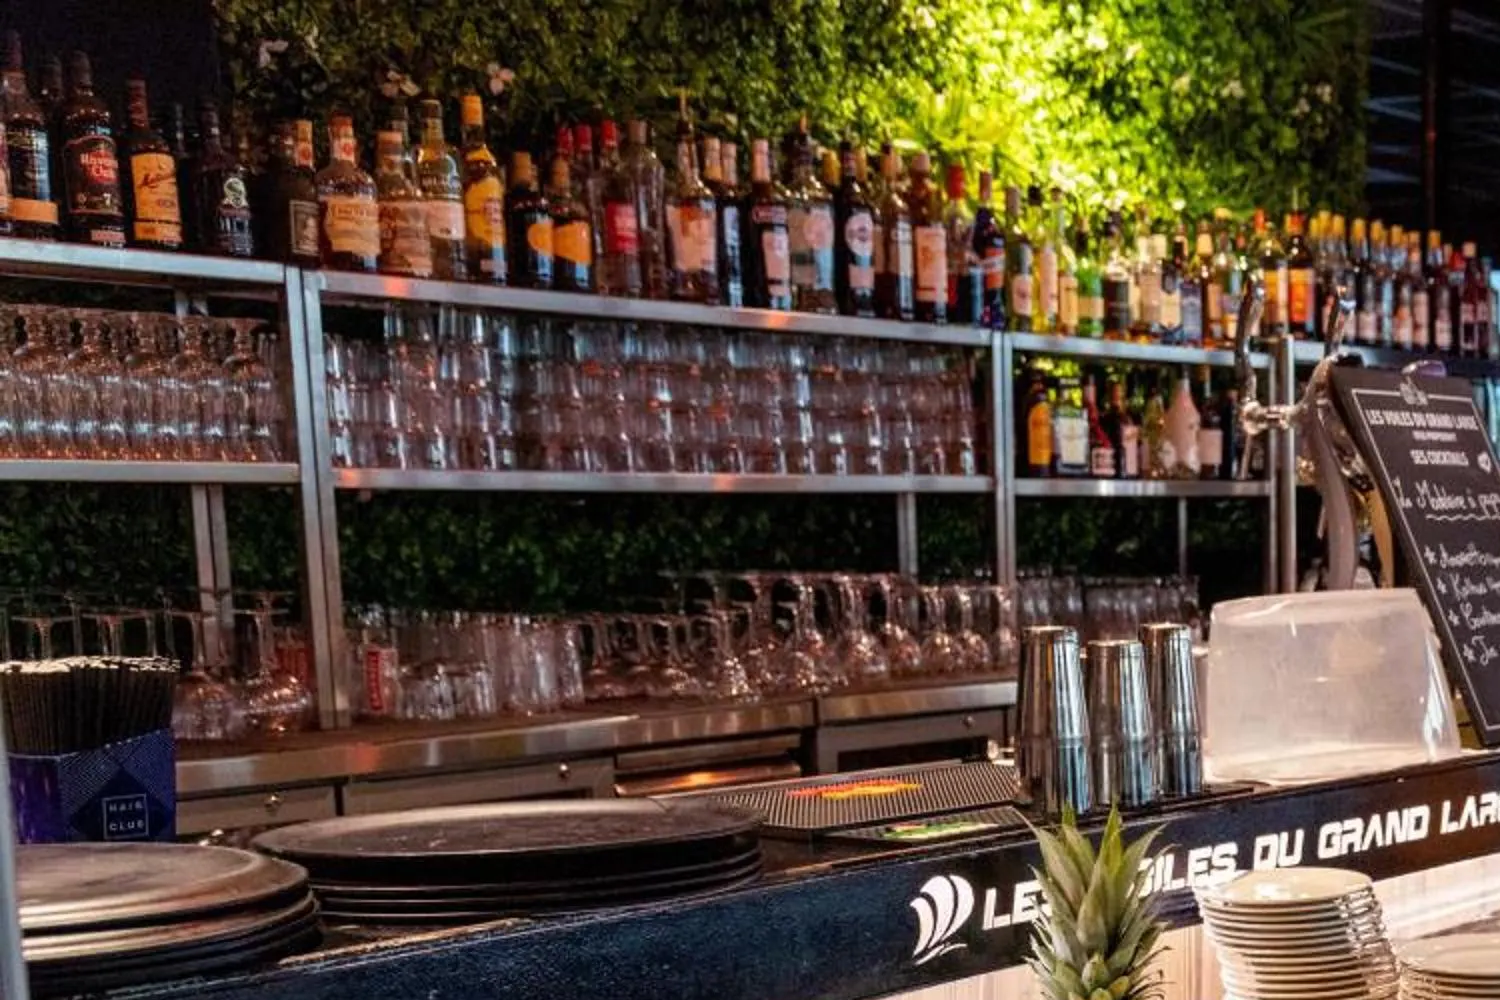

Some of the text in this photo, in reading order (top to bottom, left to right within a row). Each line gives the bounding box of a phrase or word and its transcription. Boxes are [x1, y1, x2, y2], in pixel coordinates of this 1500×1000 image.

[1365, 409, 1479, 430] LES VOILES DU GRAND LARGE
[1410, 449, 1470, 466] SES COCKTAILS
[1253, 828, 1305, 870] DU
[1317, 803, 1431, 860] GRAND
